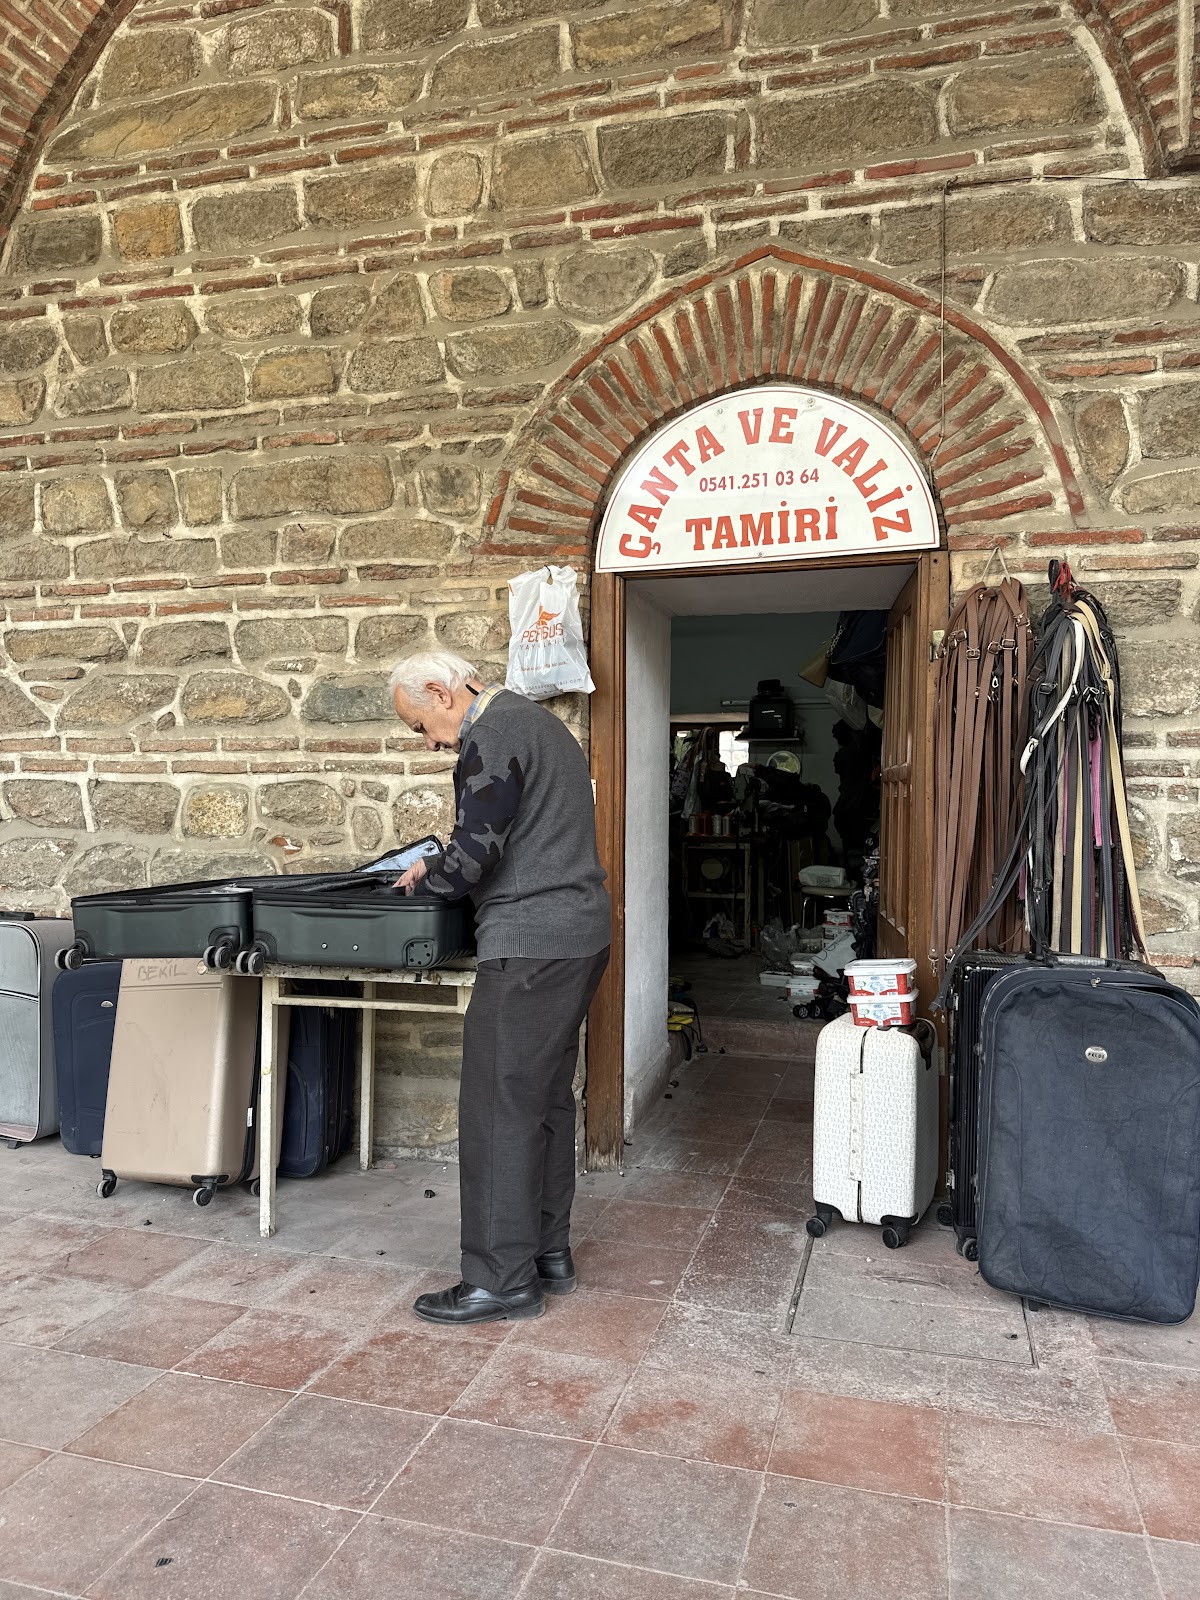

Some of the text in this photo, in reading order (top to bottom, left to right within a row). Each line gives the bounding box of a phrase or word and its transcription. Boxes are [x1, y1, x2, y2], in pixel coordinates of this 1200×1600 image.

[619, 407, 912, 558] ÇANTA VE VALİZ
[699, 469, 819, 493] 0541.251 03 64
[685, 501, 838, 551] TAMİRİ
